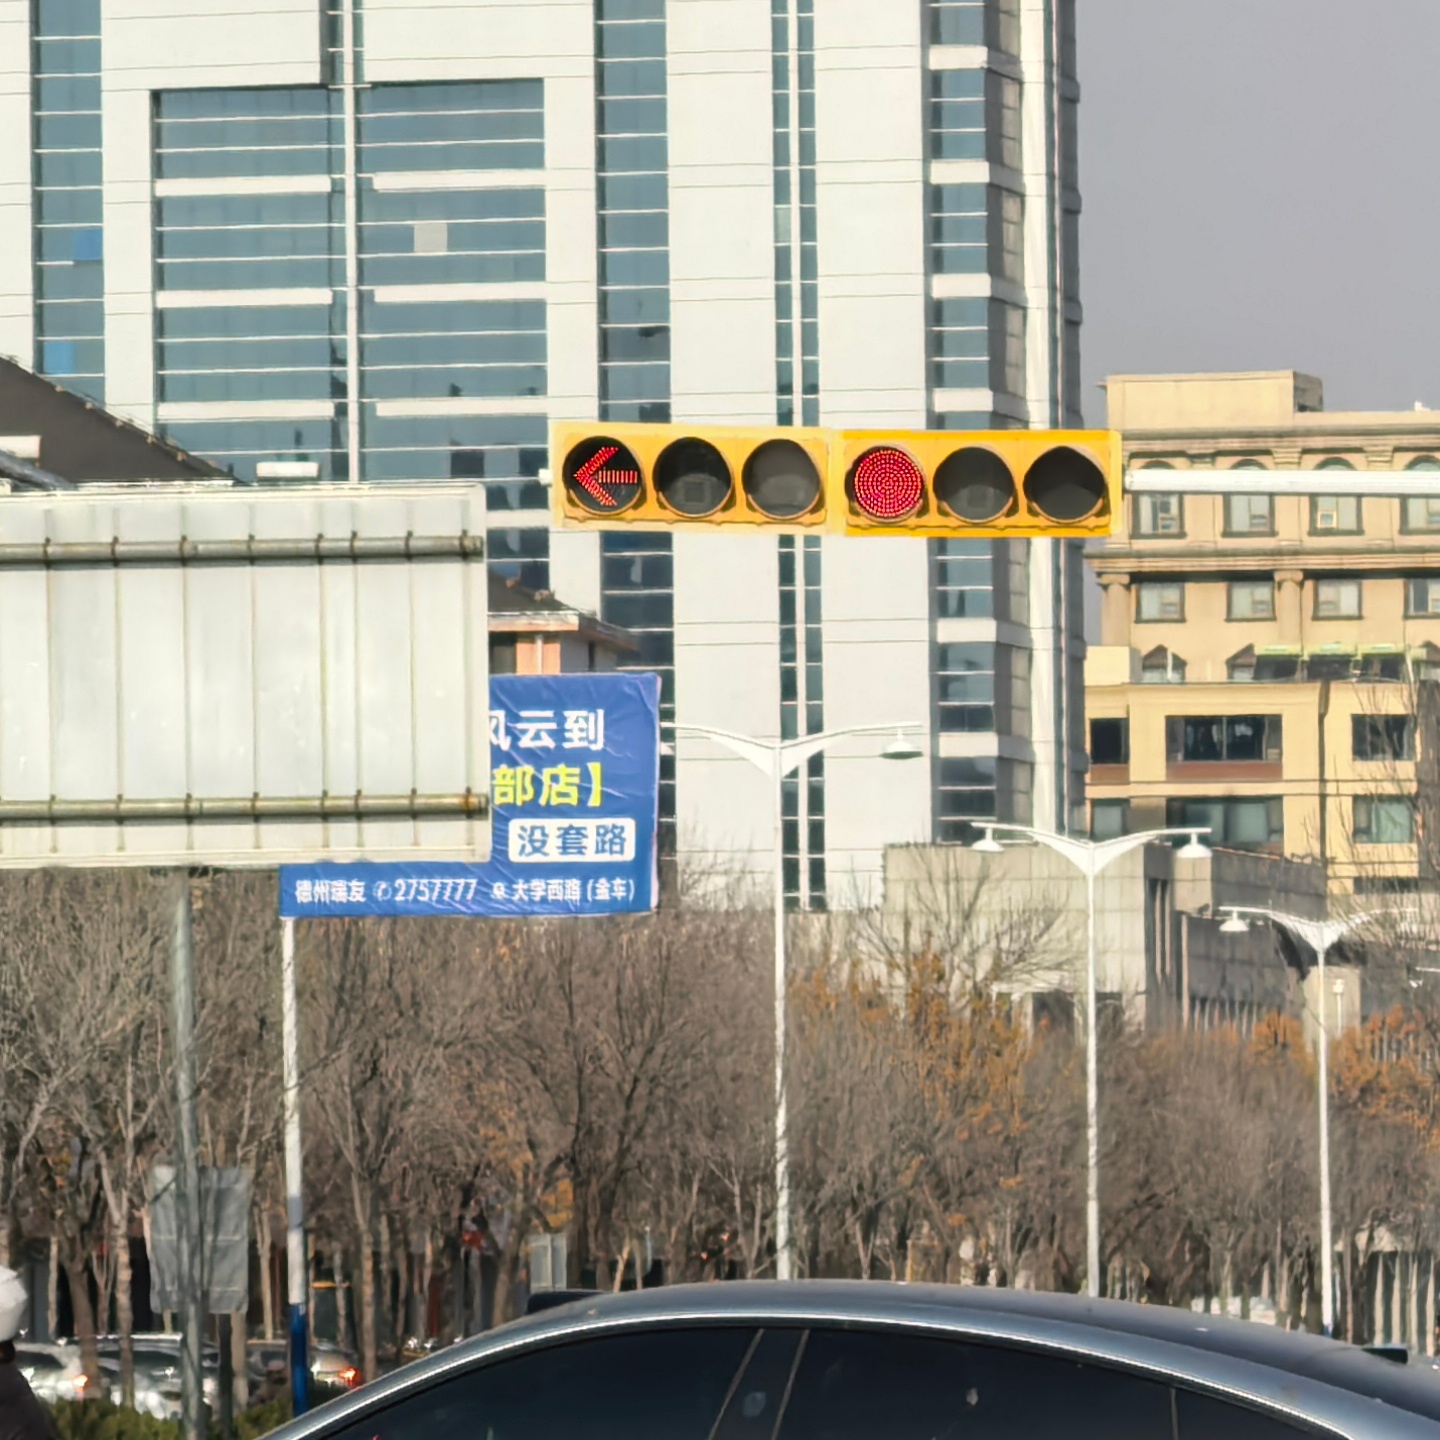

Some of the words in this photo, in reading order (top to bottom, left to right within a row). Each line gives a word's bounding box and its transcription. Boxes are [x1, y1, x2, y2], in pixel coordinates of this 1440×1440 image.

[489, 709, 605, 751] 风云到
[517, 823, 627, 858] 没套路
[394, 878, 478, 902] 2757777
